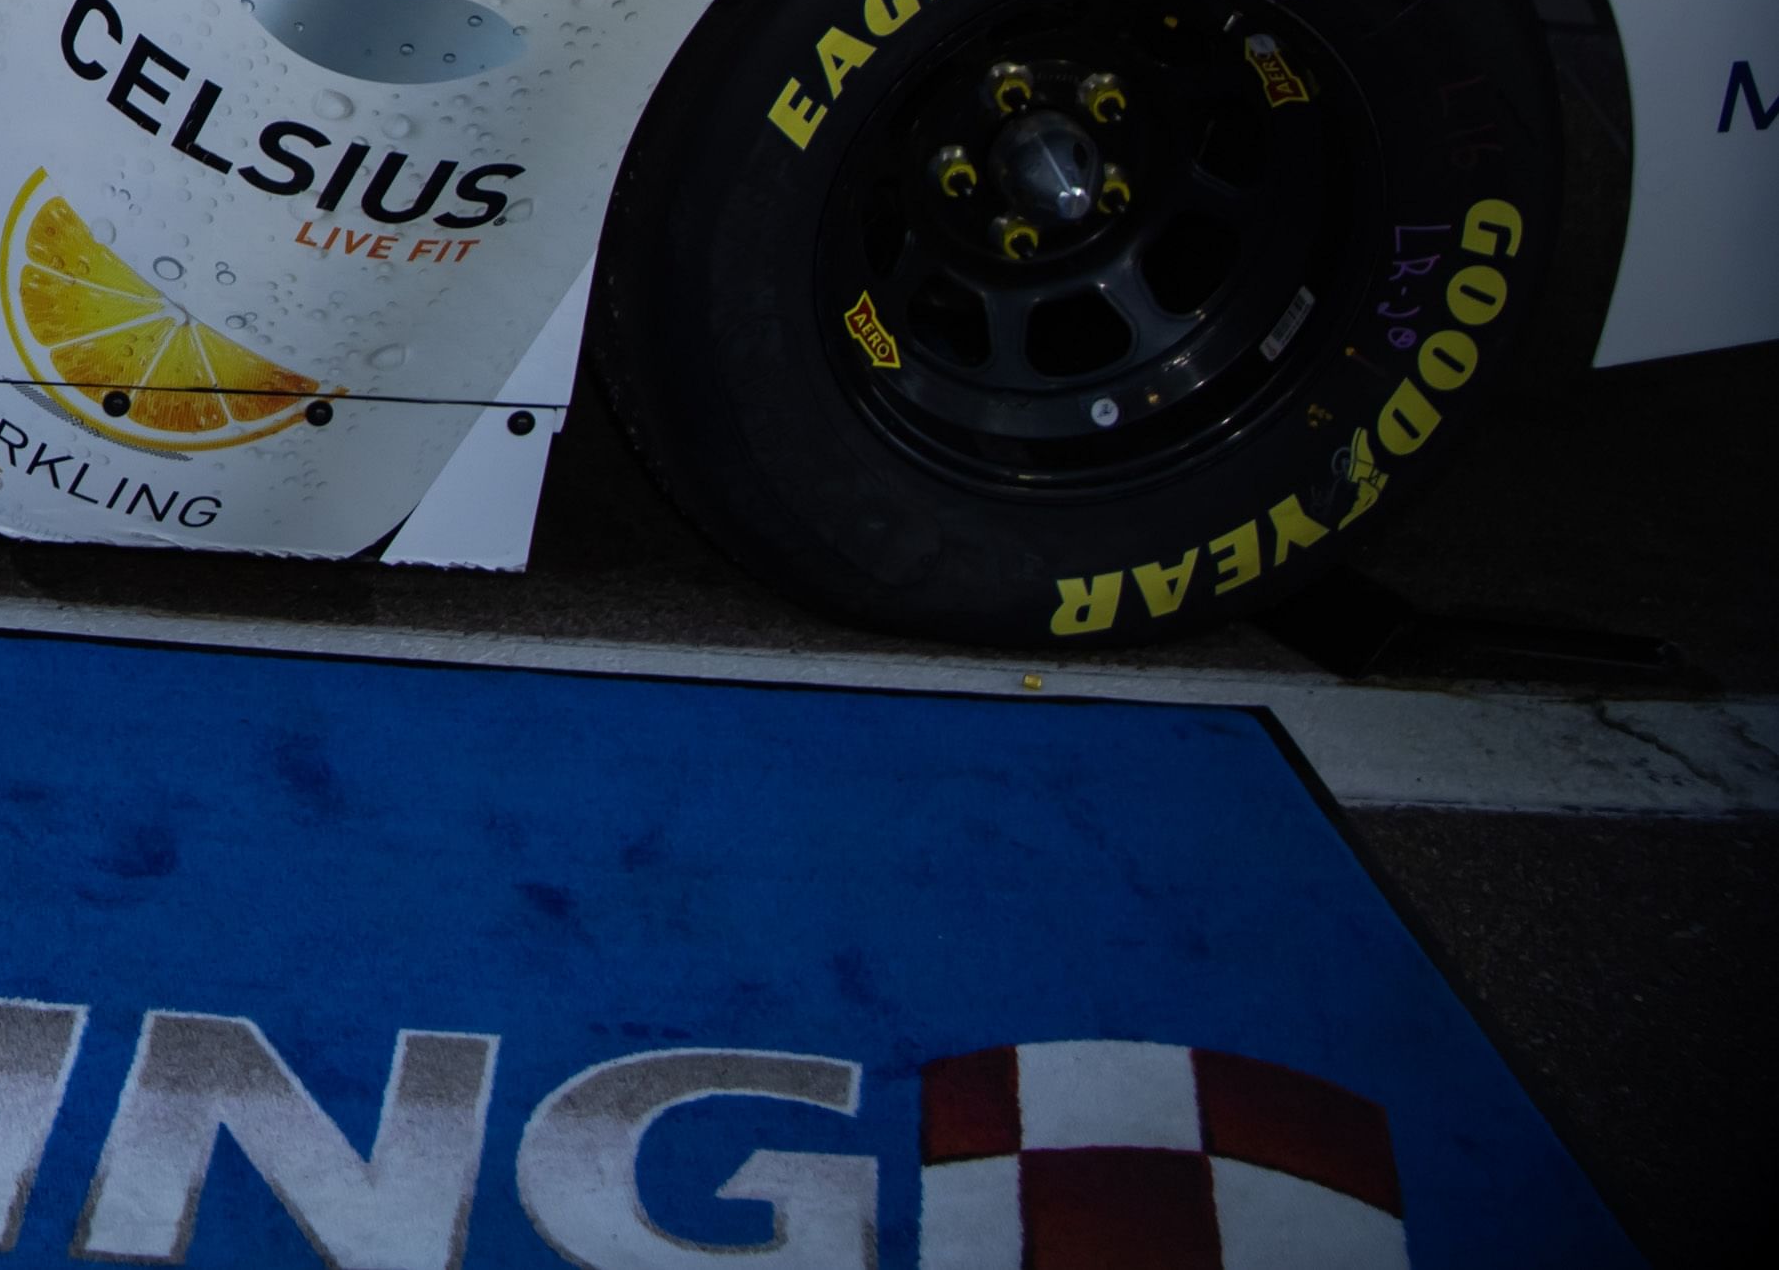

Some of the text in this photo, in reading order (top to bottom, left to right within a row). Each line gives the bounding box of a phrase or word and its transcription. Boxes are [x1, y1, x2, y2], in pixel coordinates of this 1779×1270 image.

[293, 220, 481, 263] LIVE FIT
[852, 312, 890, 359] AERO
